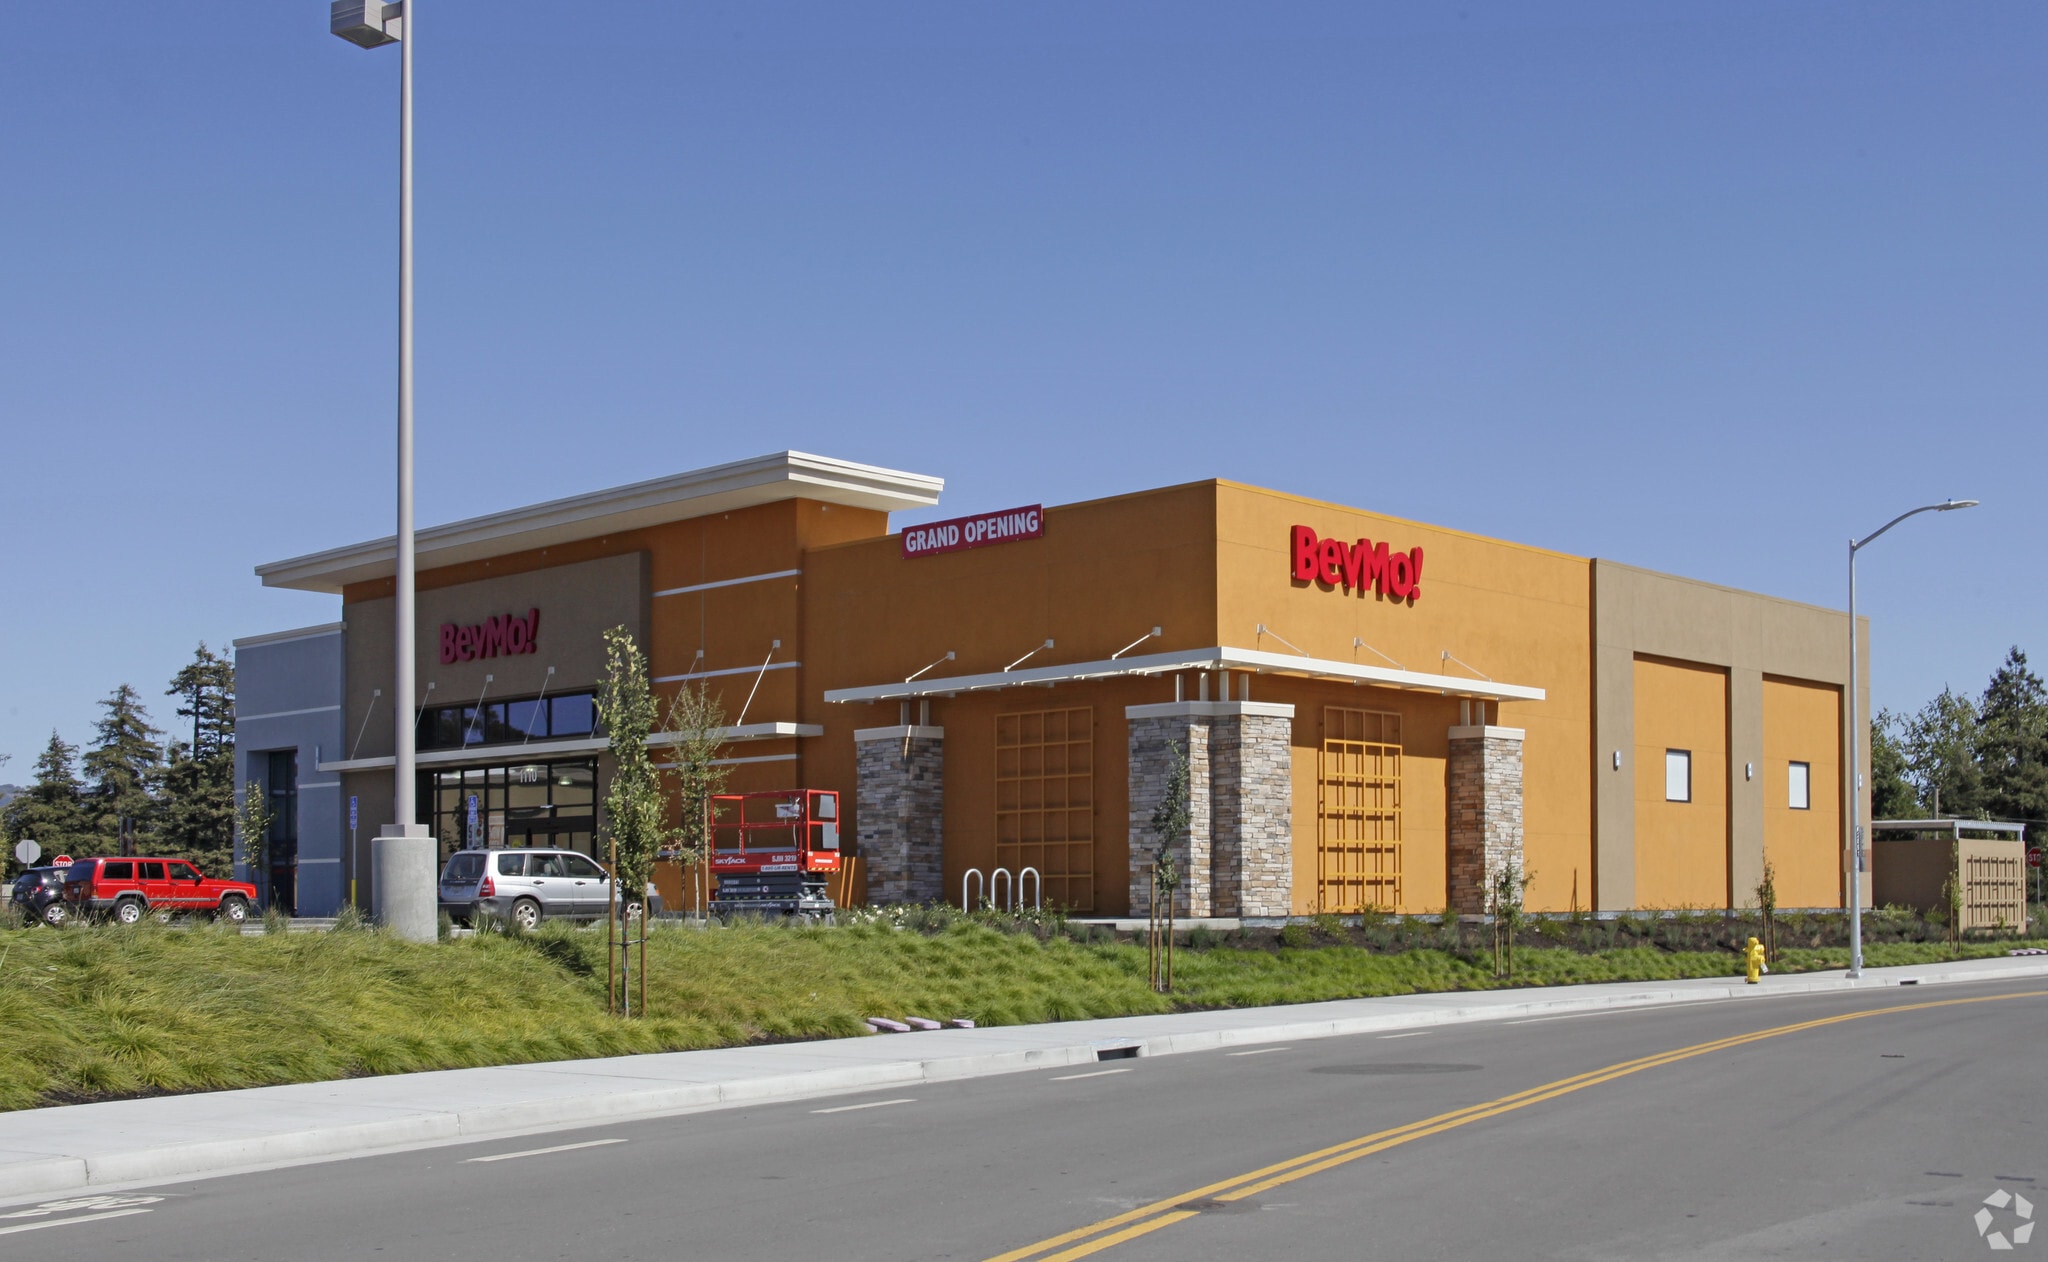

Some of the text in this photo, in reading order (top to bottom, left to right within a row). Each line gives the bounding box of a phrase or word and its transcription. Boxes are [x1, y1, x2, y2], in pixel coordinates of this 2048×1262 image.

[906, 511, 1038, 552] GRAND OPENING
[1290, 525, 1423, 600] BevMo!
[440, 608, 540, 665] BevMo!
[519, 769, 537, 783] 1110
[715, 856, 746, 865] SKYJACK
[2028, 853, 2042, 862] STO
